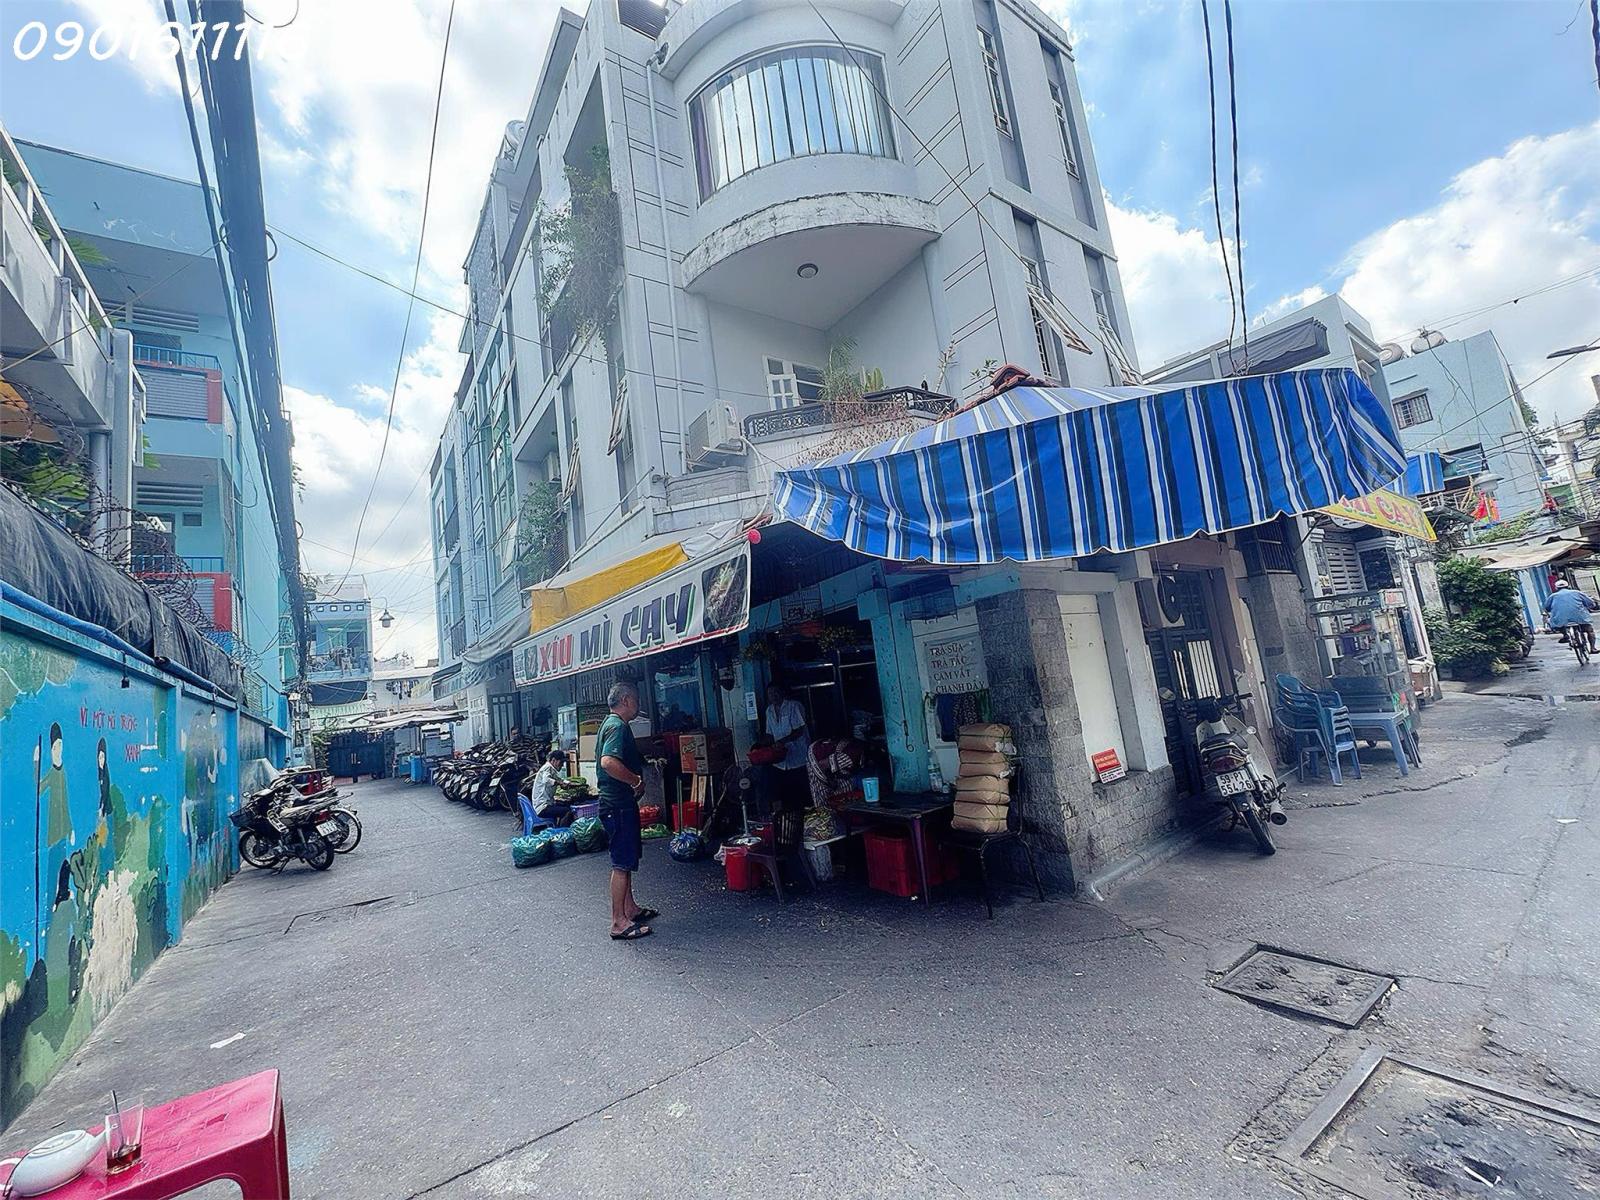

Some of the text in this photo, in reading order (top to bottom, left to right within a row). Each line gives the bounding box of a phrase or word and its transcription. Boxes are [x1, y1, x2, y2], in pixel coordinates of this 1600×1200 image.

[580, 613, 613, 665] MÌ
[619, 583, 696, 652] CAY
[931, 656, 948, 668] TRÀ
[935, 683, 965, 693] CHANH
